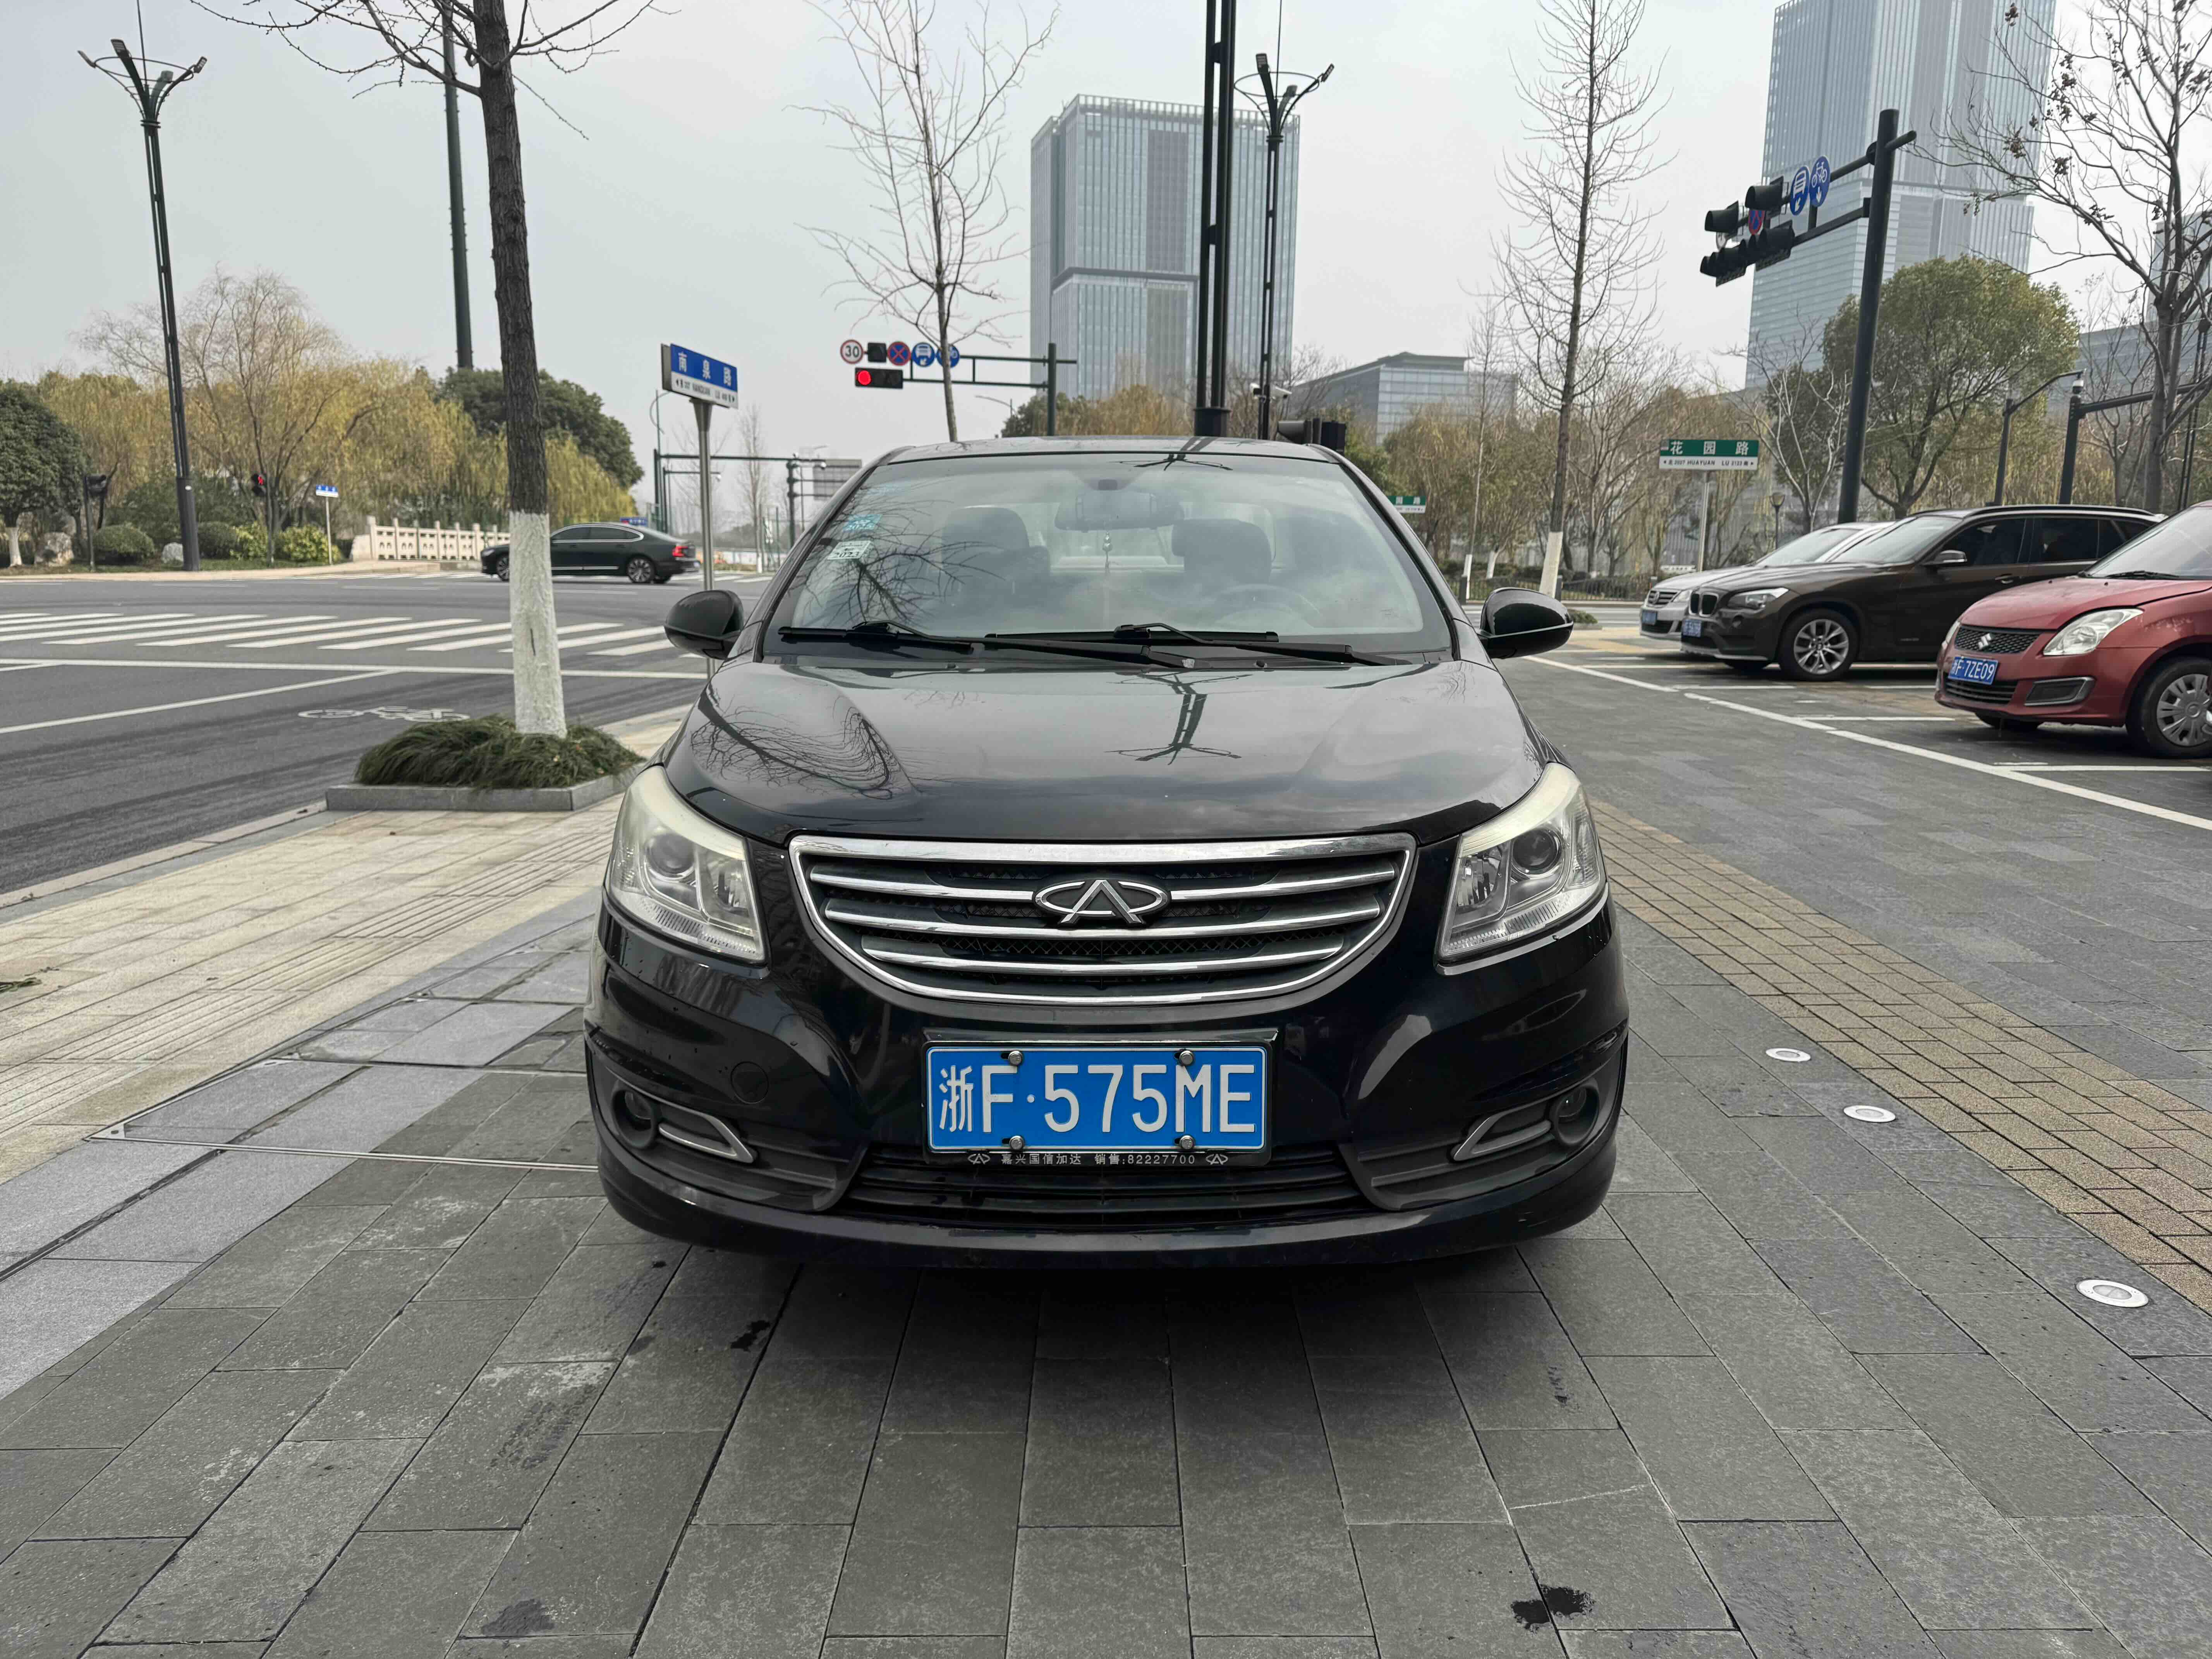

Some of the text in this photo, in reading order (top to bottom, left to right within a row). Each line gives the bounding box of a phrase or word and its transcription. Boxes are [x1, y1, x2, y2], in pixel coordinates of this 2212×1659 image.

[845, 345, 859, 358] 30
[678, 351, 732, 386] 南泉路
[1670, 441, 1748, 456] 花园路
[939, 1064, 1256, 1133] 浙F·575ME
[1001, 1154, 1195, 1165] 嘉兴国信加达 销售:82227700
